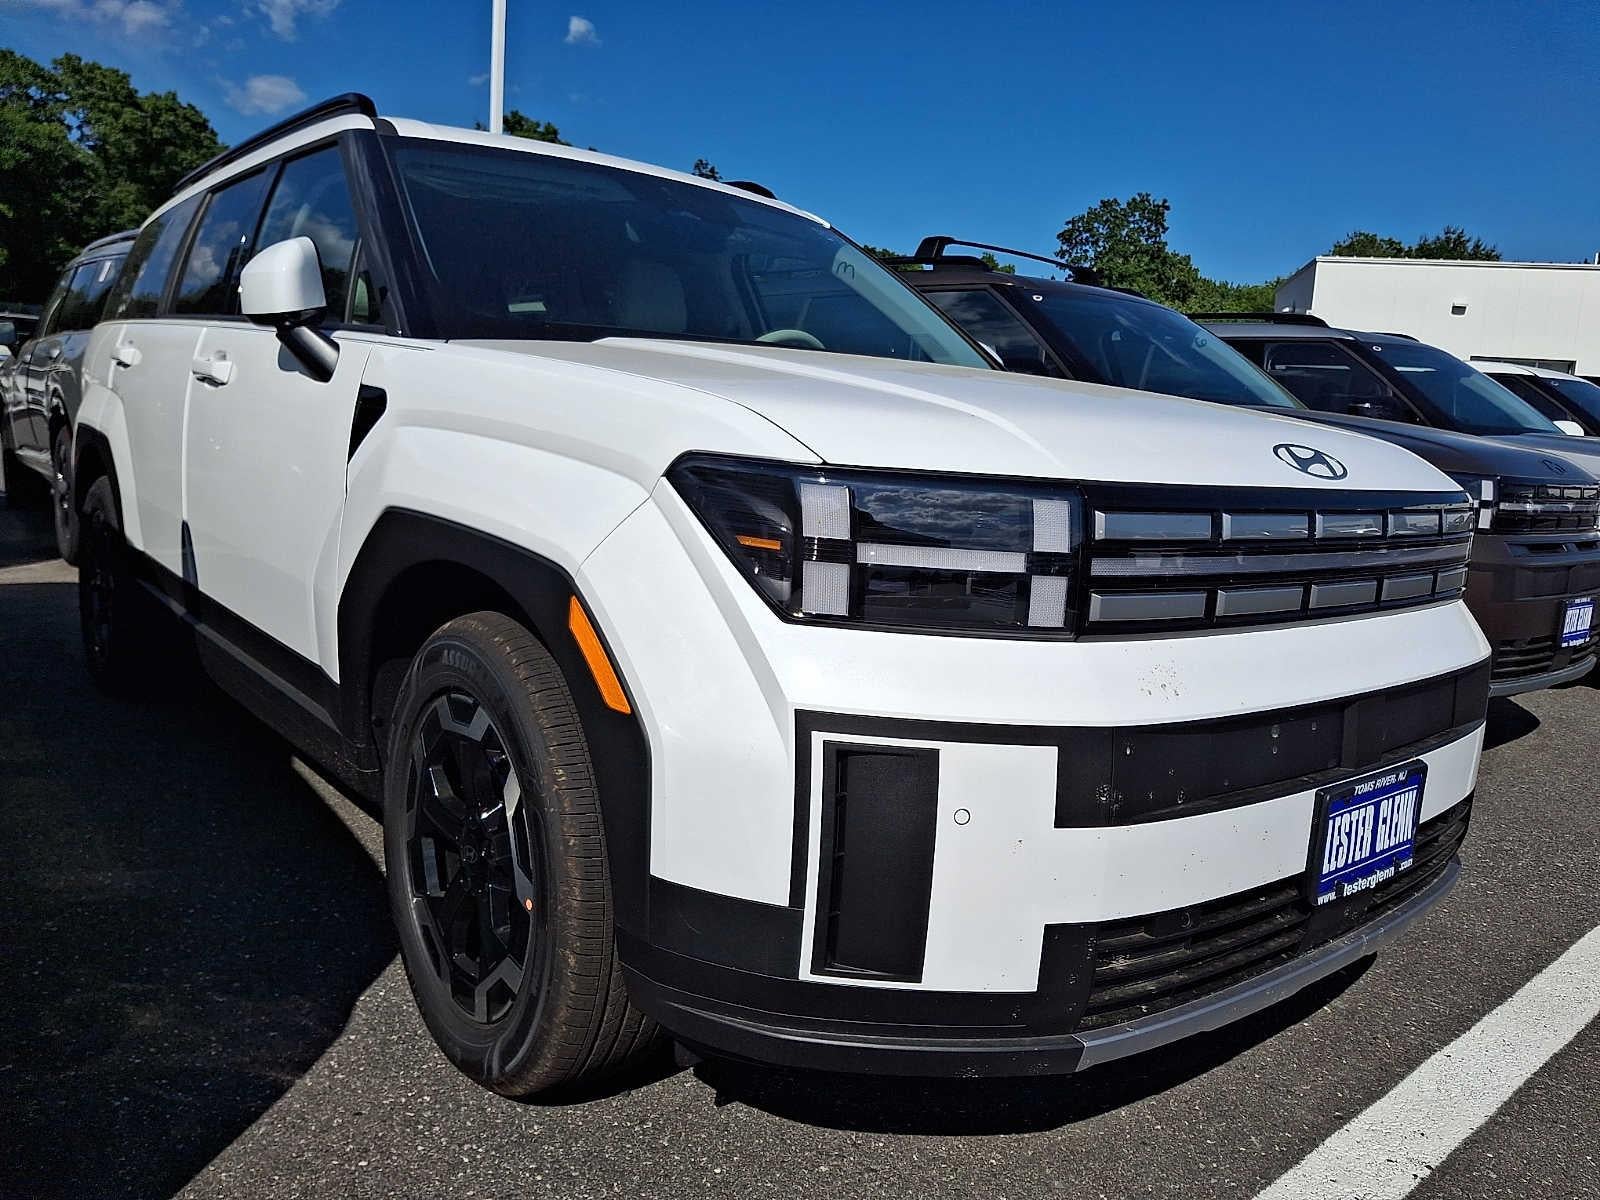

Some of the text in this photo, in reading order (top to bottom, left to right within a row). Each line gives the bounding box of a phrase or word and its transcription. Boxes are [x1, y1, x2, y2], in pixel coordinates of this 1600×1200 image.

[1354, 780, 1375, 796] TOMS
[1398, 770, 1408, 781] NJ
[1322, 790, 1418, 875] LESTER GLENN
[1317, 858, 1413, 905] www. lesterglenn .com
